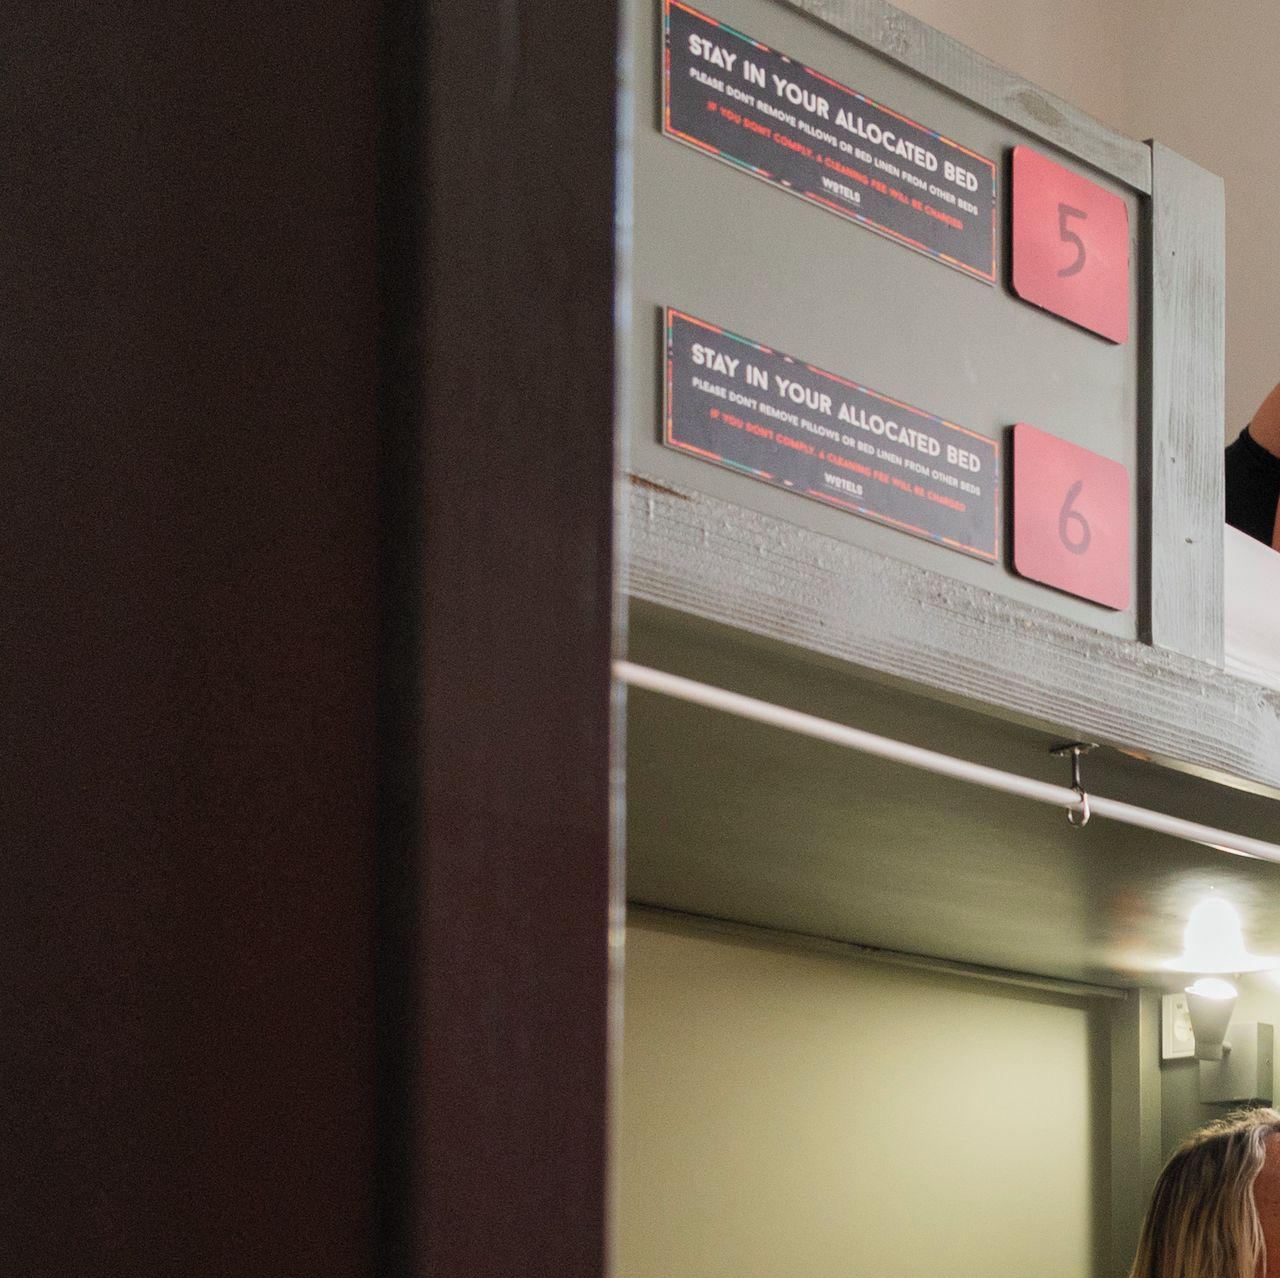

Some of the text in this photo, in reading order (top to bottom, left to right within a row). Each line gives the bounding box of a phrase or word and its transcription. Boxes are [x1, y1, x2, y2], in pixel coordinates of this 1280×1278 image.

[688, 33, 978, 192] STAY IN YOUR ALLOCATED BED
[689, 67, 725, 93] PLEASE
[756, 100, 796, 127] REMOVE
[798, 120, 838, 147] PILLOWS
[839, 140, 853, 155] OR
[854, 148, 873, 164] BED
[874, 157, 900, 178] LINEN
[901, 170, 928, 191] FROM
[929, 184, 956, 206] OTHER
[957, 198, 979, 216] BEDS
[719, 106, 742, 125] YOU
[815, 153, 823, 165] A
[824, 156, 870, 186] CLEANING
[870, 178, 888, 195] FEE
[888, 188, 910, 206] WILL
[911, 198, 923, 211] BE
[923, 205, 964, 231] CHARGED
[1057, 202, 1088, 278] 5
[691, 342, 981, 473] STAY IN YOUR ALLOCATED BED
[691, 376, 727, 400] PLEASE
[759, 402, 799, 427] REMOVE
[800, 418, 840, 442] PILLOWS
[841, 435, 856, 449] OR
[857, 441, 875, 456] BED
[876, 448, 902, 467] LINEN
[903, 459, 930, 477] FROM
[931, 470, 959, 489] OTHER
[959, 481, 981, 497] BEDS
[721, 413, 743, 430] YOU
[817, 449, 825, 460] A
[826, 452, 872, 477] CLEANING
[872, 470, 890, 485] FEE
[891, 477, 913, 493] WILL
[913, 484, 925, 498] BE
[926, 490, 967, 513] CHARGED
[1058, 479, 1091, 556] 6
